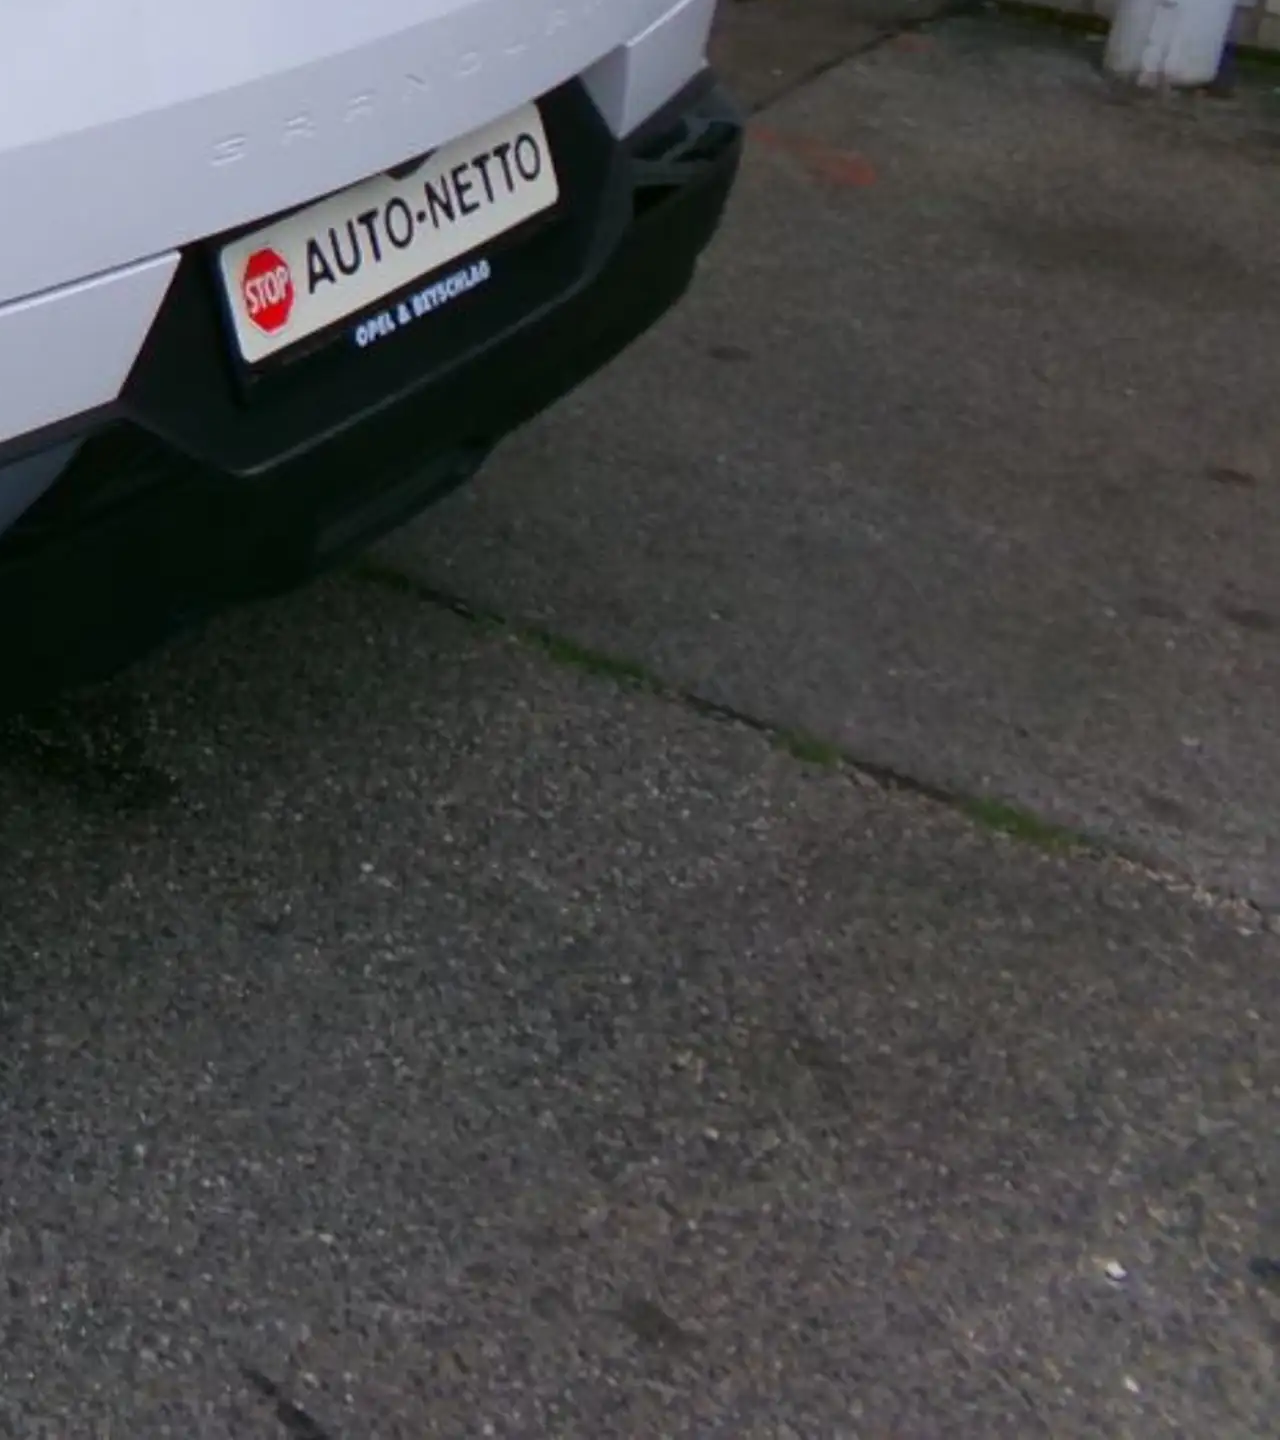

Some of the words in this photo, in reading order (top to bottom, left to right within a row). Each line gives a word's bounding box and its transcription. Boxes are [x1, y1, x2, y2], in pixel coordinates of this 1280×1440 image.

[244, 266, 290, 314] STOP
[306, 133, 540, 295] AUTO-NETTO
[355, 312, 396, 348] OPEL
